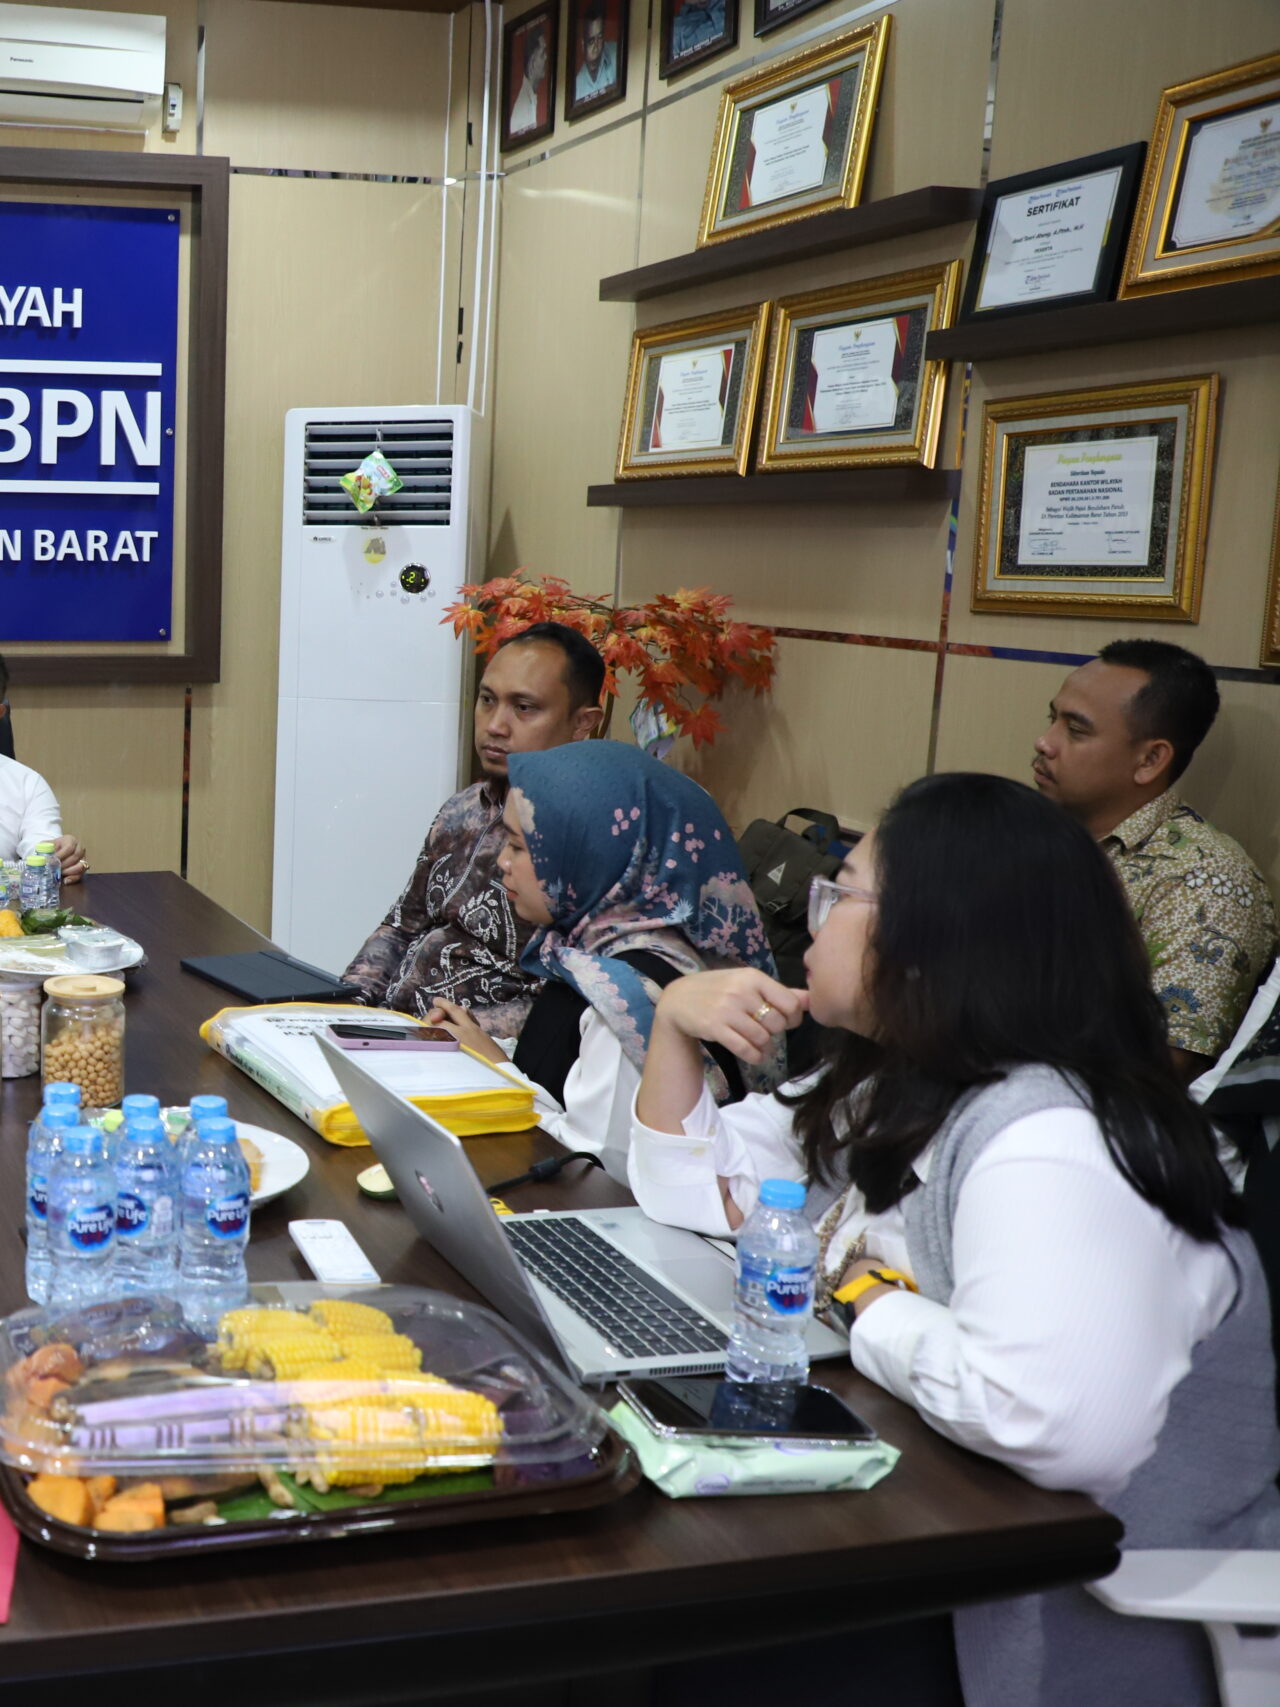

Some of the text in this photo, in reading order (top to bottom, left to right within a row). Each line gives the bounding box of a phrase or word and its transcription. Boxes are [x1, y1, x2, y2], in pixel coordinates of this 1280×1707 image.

[1027, 196, 1081, 217] SERTIFIKAT
[34, 529, 159, 562] BARAT
[126, 1207, 147, 1225] Life
[207, 1210, 235, 1222] Pure
[68, 1220, 97, 1234] Pure
[767, 1280, 800, 1295] Pure
